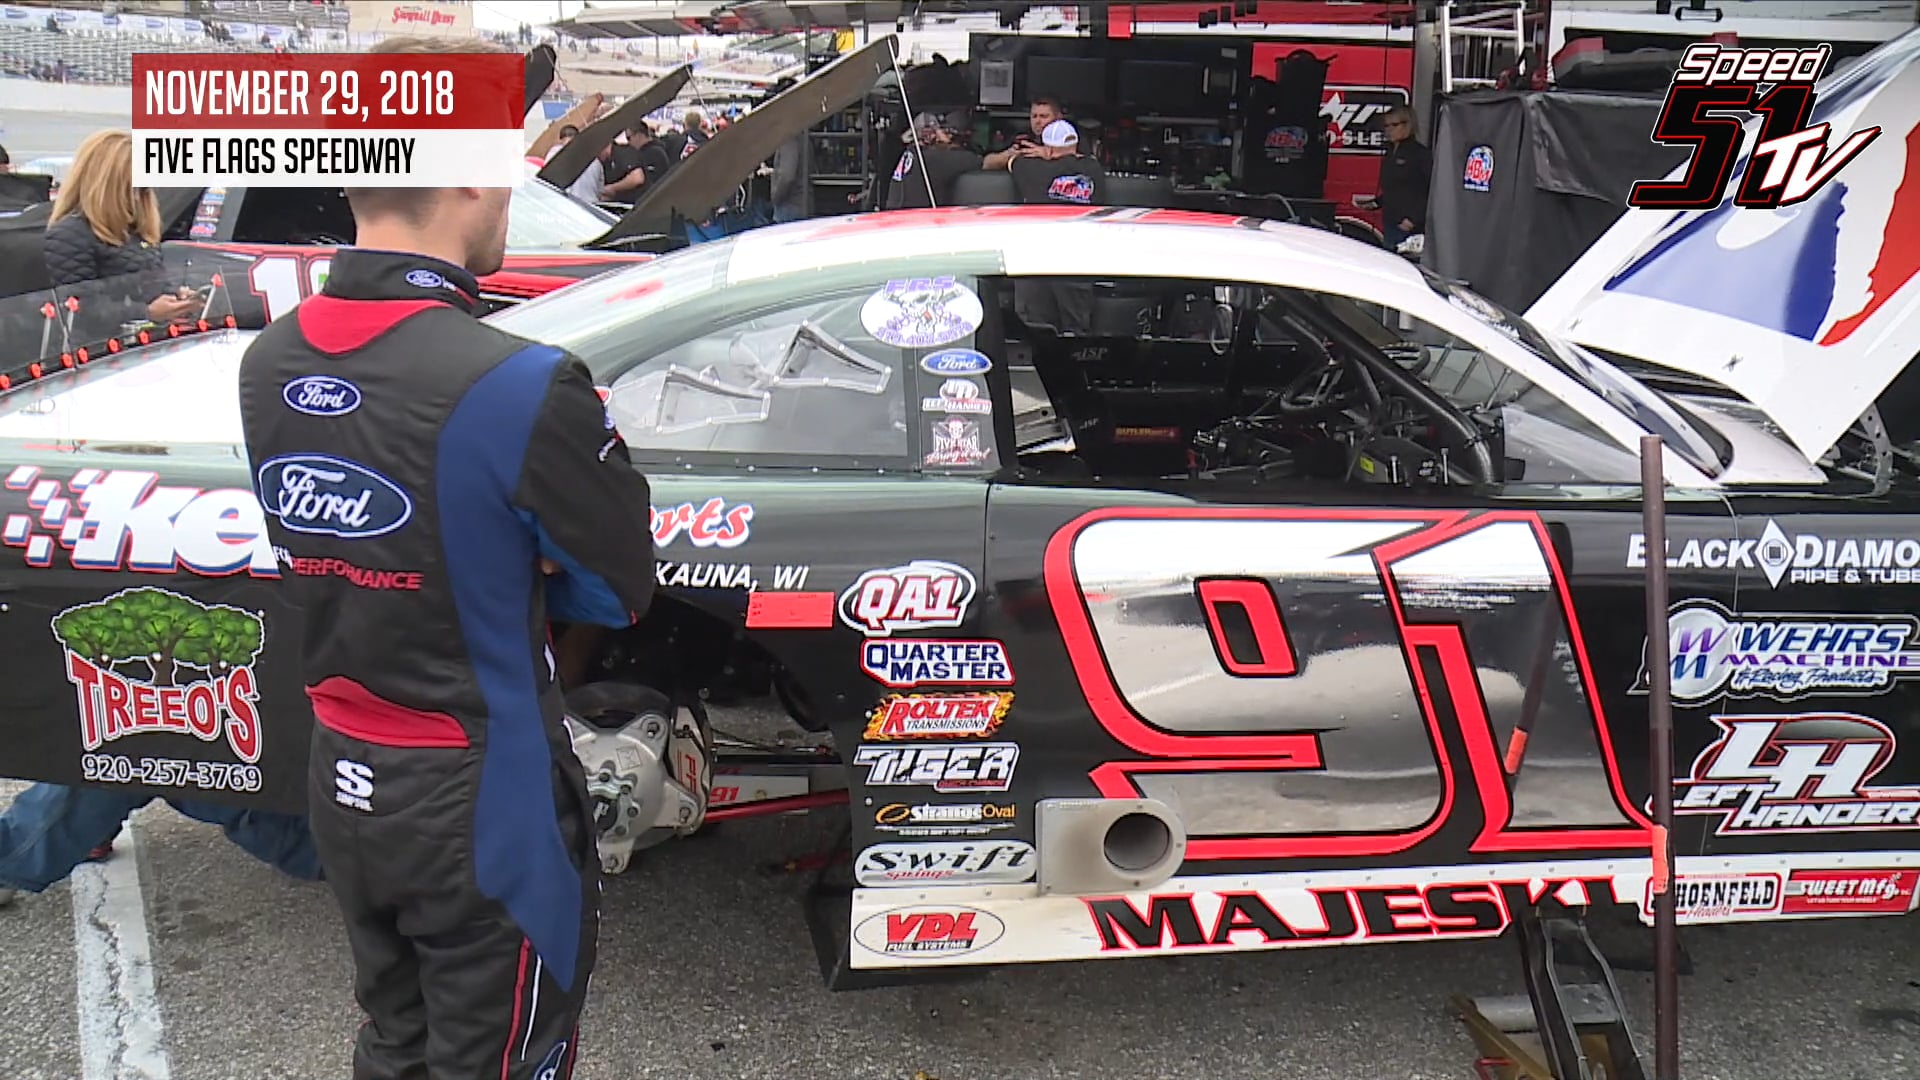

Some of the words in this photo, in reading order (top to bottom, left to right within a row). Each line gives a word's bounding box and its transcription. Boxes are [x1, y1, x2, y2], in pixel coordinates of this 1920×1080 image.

[938, 353, 978, 370] Ford
[298, 380, 347, 409] Ford
[278, 463, 374, 528] Ford
[773, 564, 810, 590] WI
[1790, 568, 1840, 584] PIPE
[1844, 568, 1862, 584] &
[1867, 568, 1920, 584] TUBE
[854, 576, 960, 631] QA1
[1740, 627, 1905, 652] WEHRS
[866, 643, 999, 669] QUARTER
[1719, 653, 1920, 667] MACHINE
[890, 661, 1005, 682] MASTER
[1044, 507, 1653, 862] 91
[67, 648, 263, 764] TREEO'S
[883, 700, 995, 733] ROLTEK
[906, 718, 987, 730] TRANSMISSIONS
[81, 753, 263, 793] 920-257-3769
[858, 746, 1016, 784] TIGER
[1673, 783, 1774, 808] EFT
[1650, 879, 1776, 908] HOENFELD
[886, 911, 979, 944] VDL
[885, 942, 915, 951] FUEL
[916, 940, 972, 951] SYSTEMS
